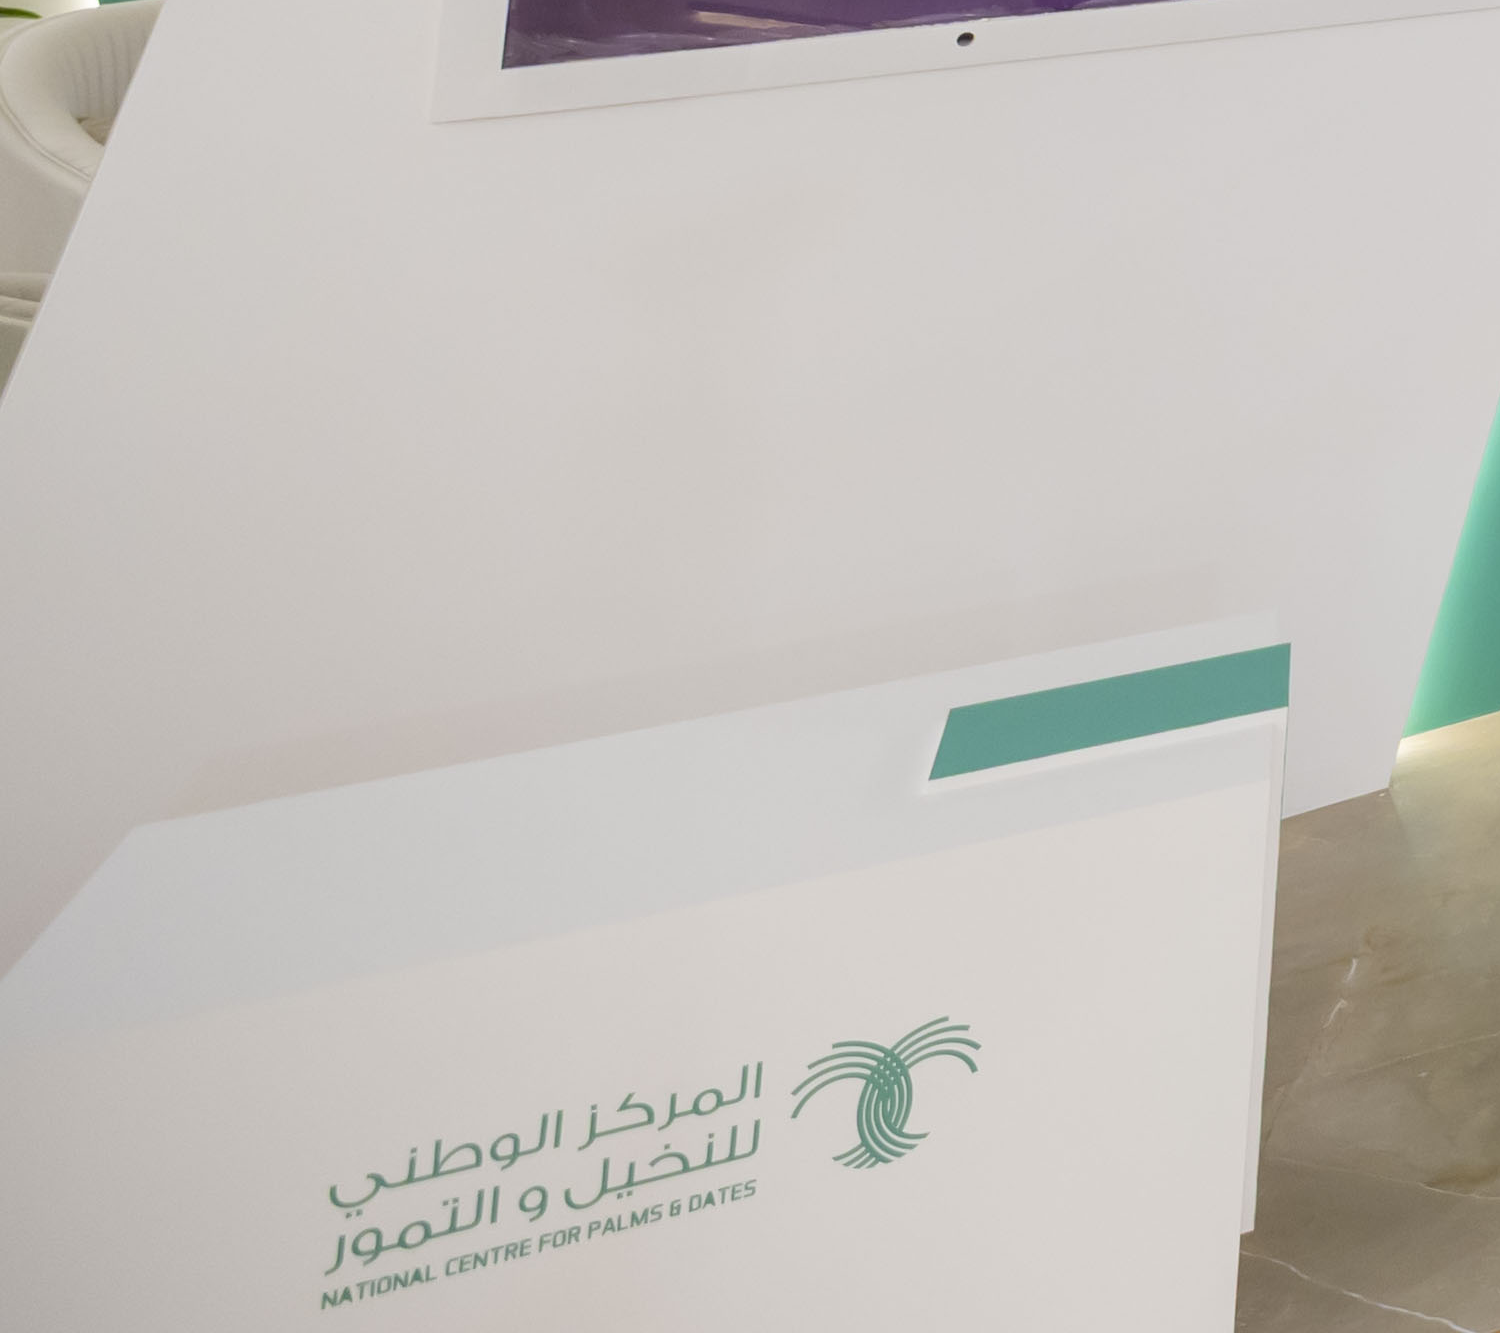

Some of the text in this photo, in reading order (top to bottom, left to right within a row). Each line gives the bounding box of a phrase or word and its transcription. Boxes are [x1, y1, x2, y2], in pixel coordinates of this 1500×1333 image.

[324, 1119, 761, 1276] للنخيل و التمور
[329, 1061, 763, 1218] المركز الوطني
[320, 1180, 757, 1310] NATIONAL CENTRE FOR PALMS & DATES
